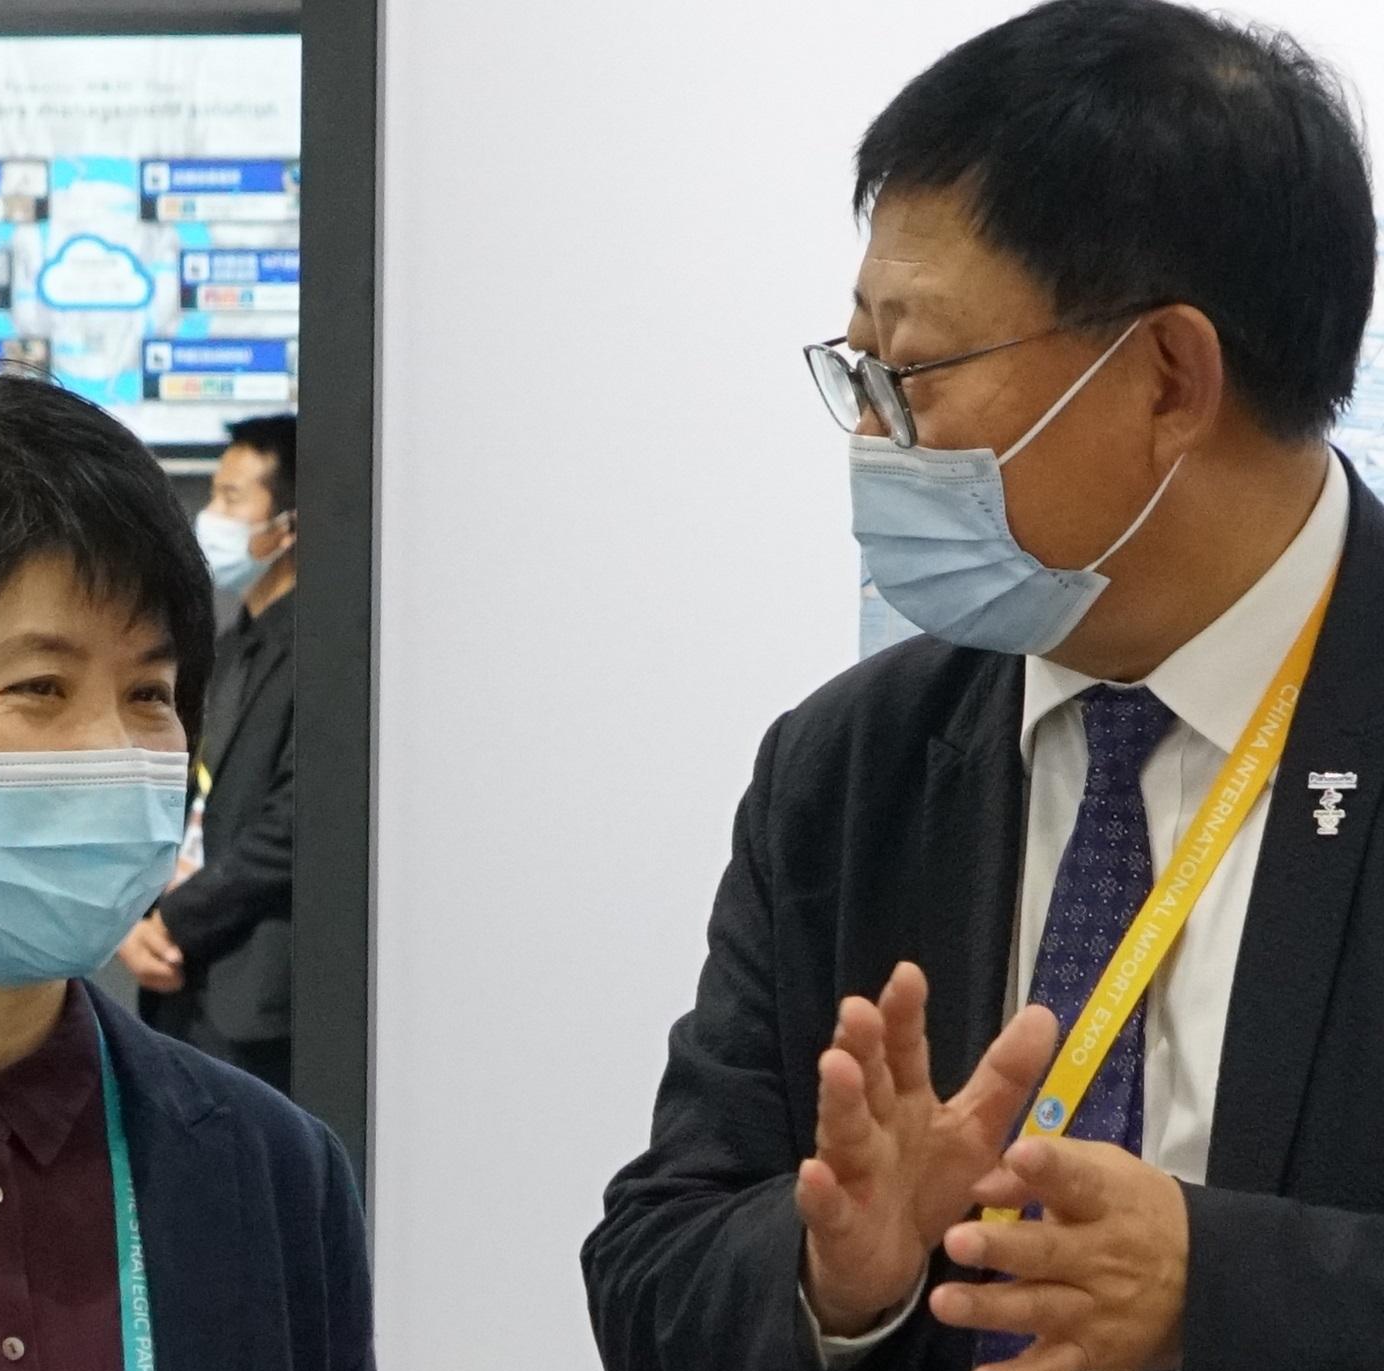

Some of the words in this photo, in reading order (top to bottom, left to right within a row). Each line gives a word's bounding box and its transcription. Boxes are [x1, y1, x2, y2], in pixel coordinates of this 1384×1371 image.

[1253, 683, 1300, 749] CHINA
[1152, 753, 1260, 918] INTERNATIONAL
[1107, 921, 1162, 1004] IMPORT
[1071, 1007, 1112, 1066] EXPO
